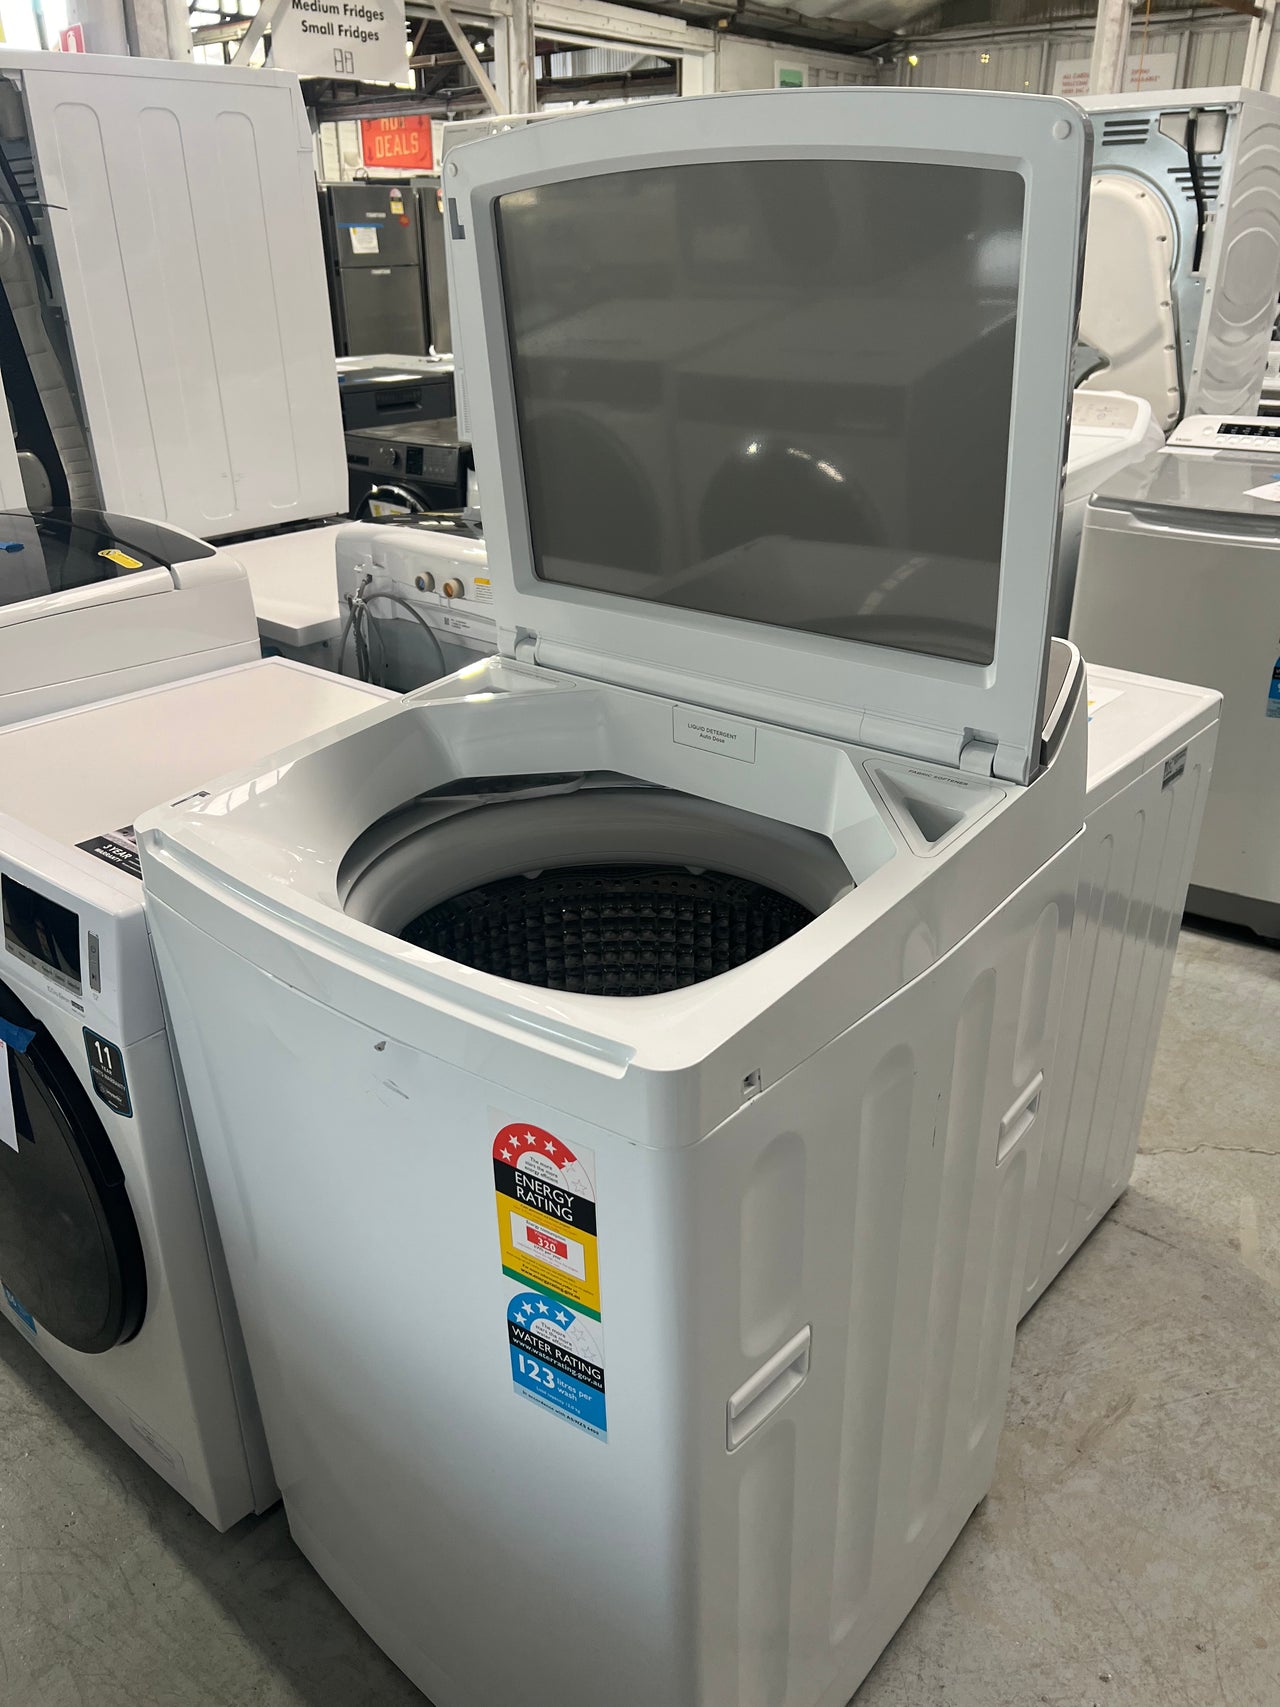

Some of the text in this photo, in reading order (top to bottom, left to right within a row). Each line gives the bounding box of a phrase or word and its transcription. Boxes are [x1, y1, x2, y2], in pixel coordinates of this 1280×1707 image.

[292, 0, 385, 22] Medium Fridges
[301, 20, 380, 43] Small Fridges
[375, 132, 420, 159] DEALS
[687, 723, 737, 740] LIQUID DETERGENT
[94, 1040, 113, 1070] 11
[514, 1171, 574, 1207] ENERGY
[516, 1186, 573, 1221] RATING
[537, 1237, 556, 1253] 320
[511, 1325, 602, 1381] WATER RATING
[518, 1353, 556, 1389] 123
[556, 1376, 593, 1403] litres per
[557, 1387, 578, 1402] wash
